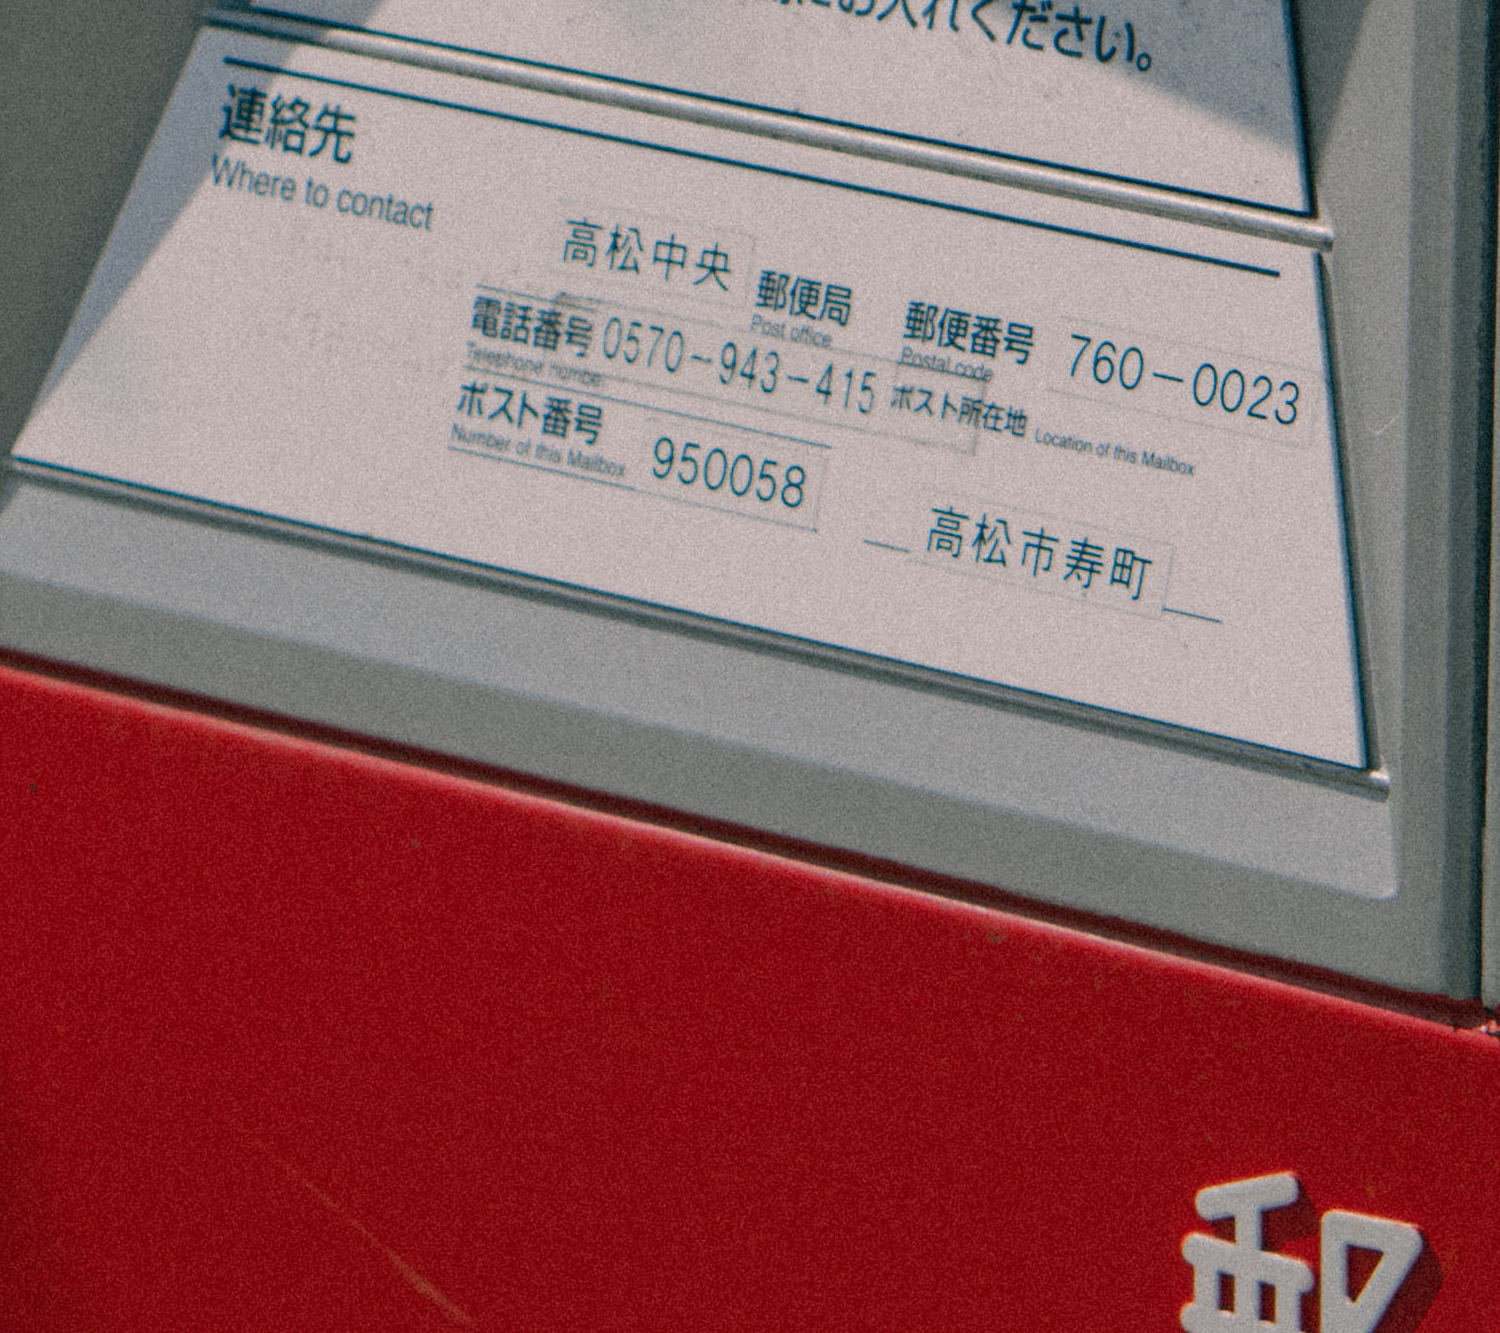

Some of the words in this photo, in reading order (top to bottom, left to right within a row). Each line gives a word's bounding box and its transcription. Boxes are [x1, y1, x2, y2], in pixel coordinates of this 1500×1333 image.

[216, 82, 358, 165] 連絡先
[211, 153, 298, 205] Where
[304, 177, 331, 210] to
[336, 184, 435, 233] contact
[562, 216, 732, 293] 高松中央
[755, 268, 853, 328] 郵便局
[470, 295, 594, 359] 電話番号
[903, 299, 1036, 366] 郵便番号
[1069, 332, 1301, 426] 760-0023
[456, 380, 603, 446] ポスト番号
[890, 383, 1029, 438] ポスト所在地
[652, 436, 808, 509] 950058
[926, 504, 1154, 602] 高松市寿町
